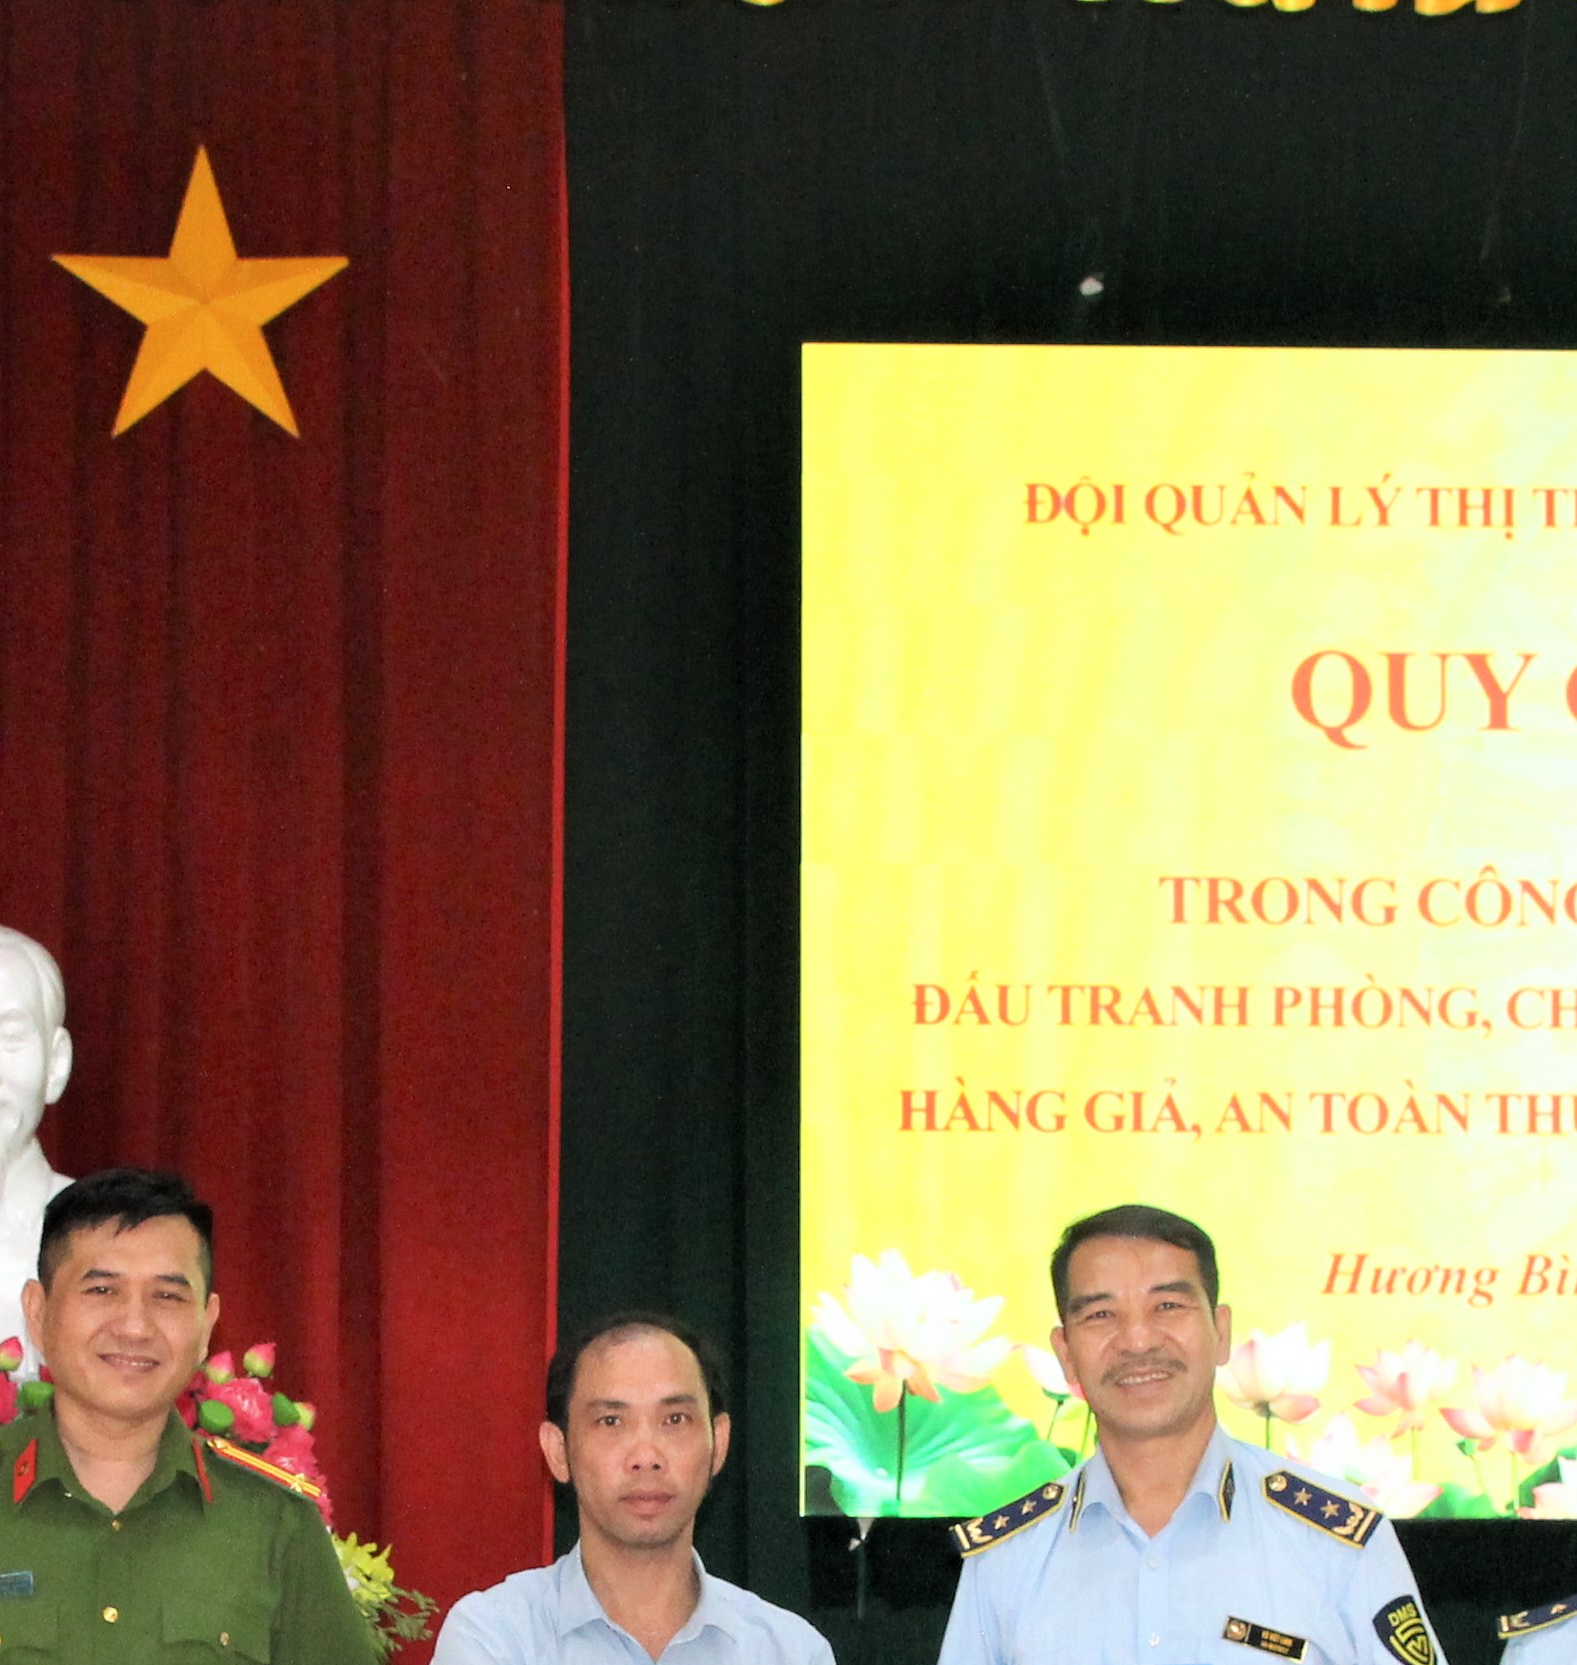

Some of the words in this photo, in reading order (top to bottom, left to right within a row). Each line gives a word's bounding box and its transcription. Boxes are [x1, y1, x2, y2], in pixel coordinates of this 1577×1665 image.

[1025, 476, 1126, 537] ĐỘI
[1143, 471, 1307, 536] QUẢN
[1329, 472, 1402, 527] LÝ
[1415, 487, 1515, 540] THỊ
[1291, 649, 1536, 750] QUY
[1158, 876, 1398, 926] TRONG
[912, 970, 1031, 1027] ĐẤU
[1047, 984, 1249, 1027] TRANH
[1273, 973, 1492, 1036] PHÒNG,
[899, 1075, 1067, 1133] HÀNG
[1083, 1078, 1203, 1140] GIẢ,
[1215, 1092, 1293, 1133] AN
[1309, 1079, 1470, 1135] TOÀN
[1321, 1253, 1499, 1307] Hương
[1387, 1602, 1417, 1627] DMS
